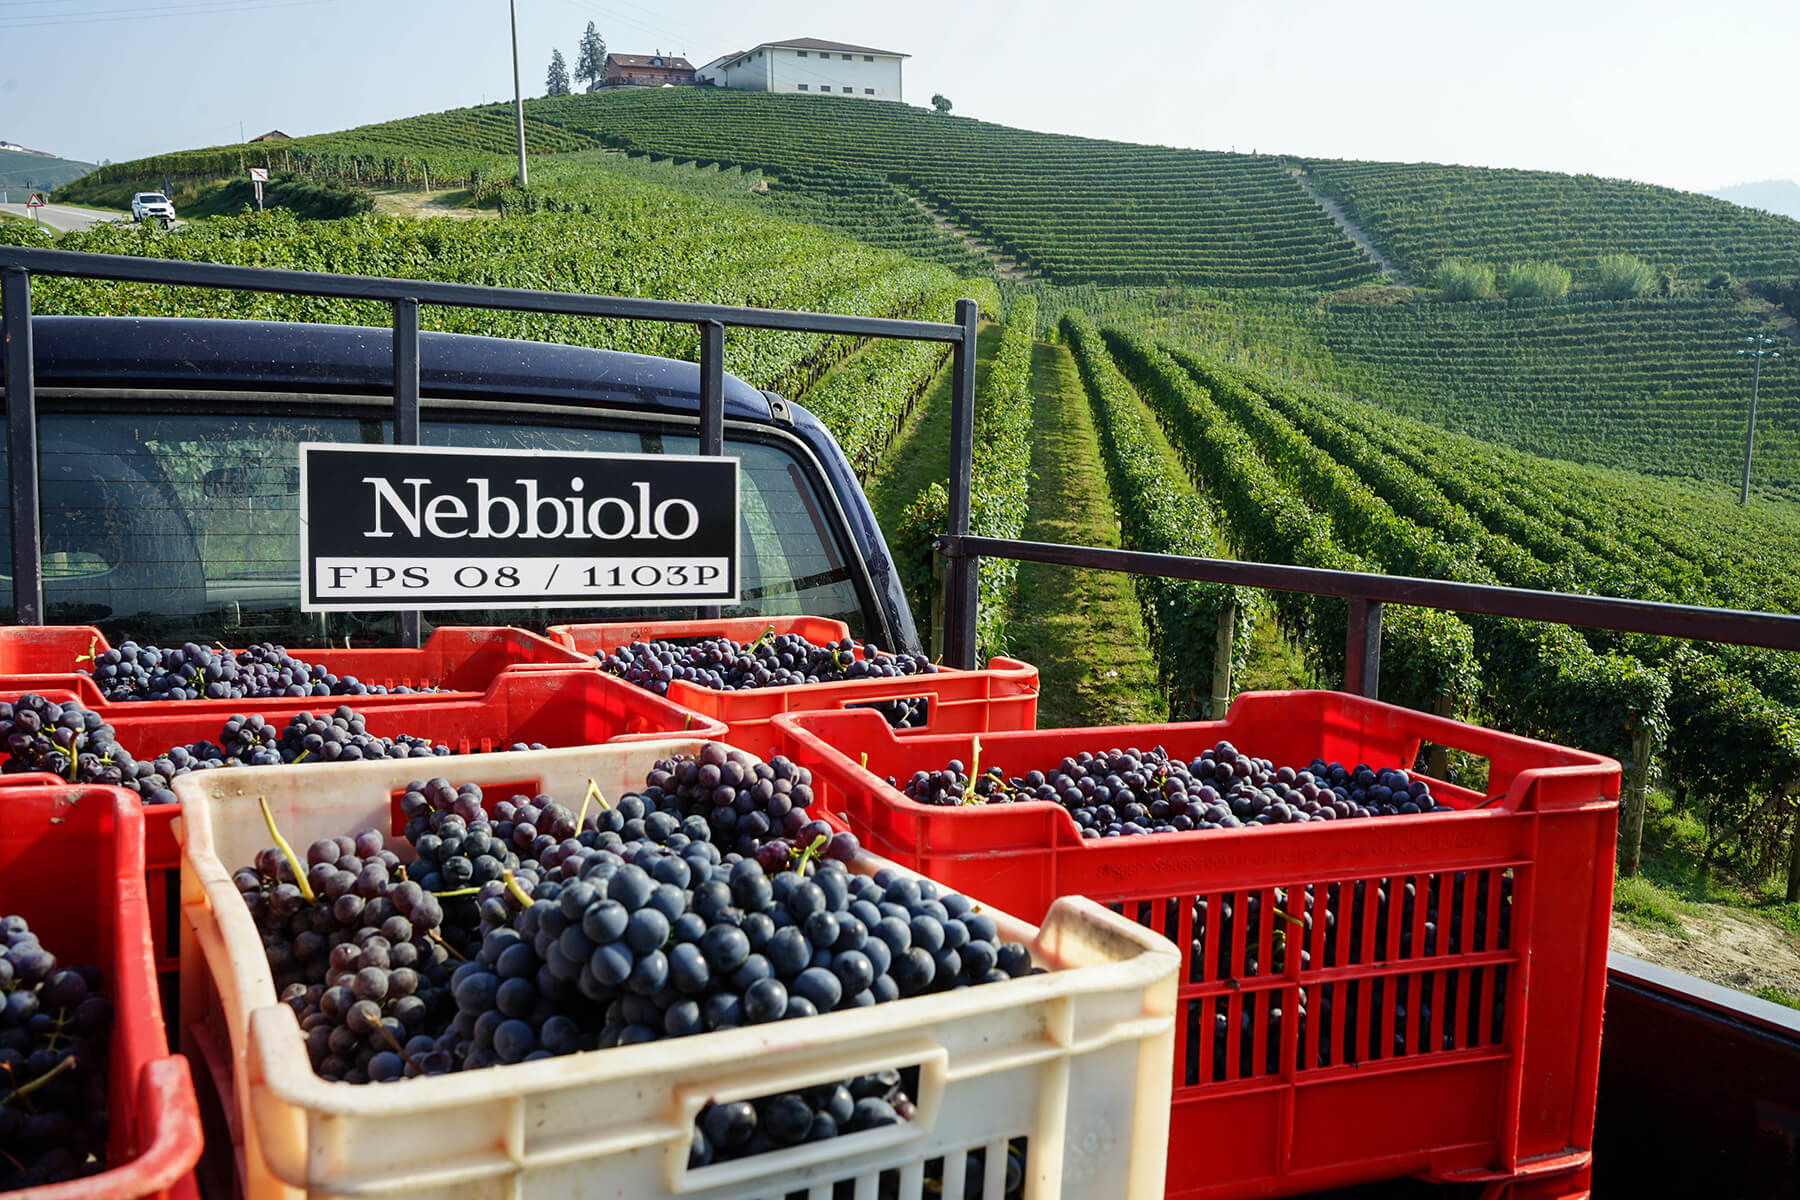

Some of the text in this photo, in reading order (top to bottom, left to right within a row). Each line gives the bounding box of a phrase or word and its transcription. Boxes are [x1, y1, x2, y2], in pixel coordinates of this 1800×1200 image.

[362, 476, 700, 540] Nebbiolo
[327, 563, 720, 590] FPS 08 / 1103P
